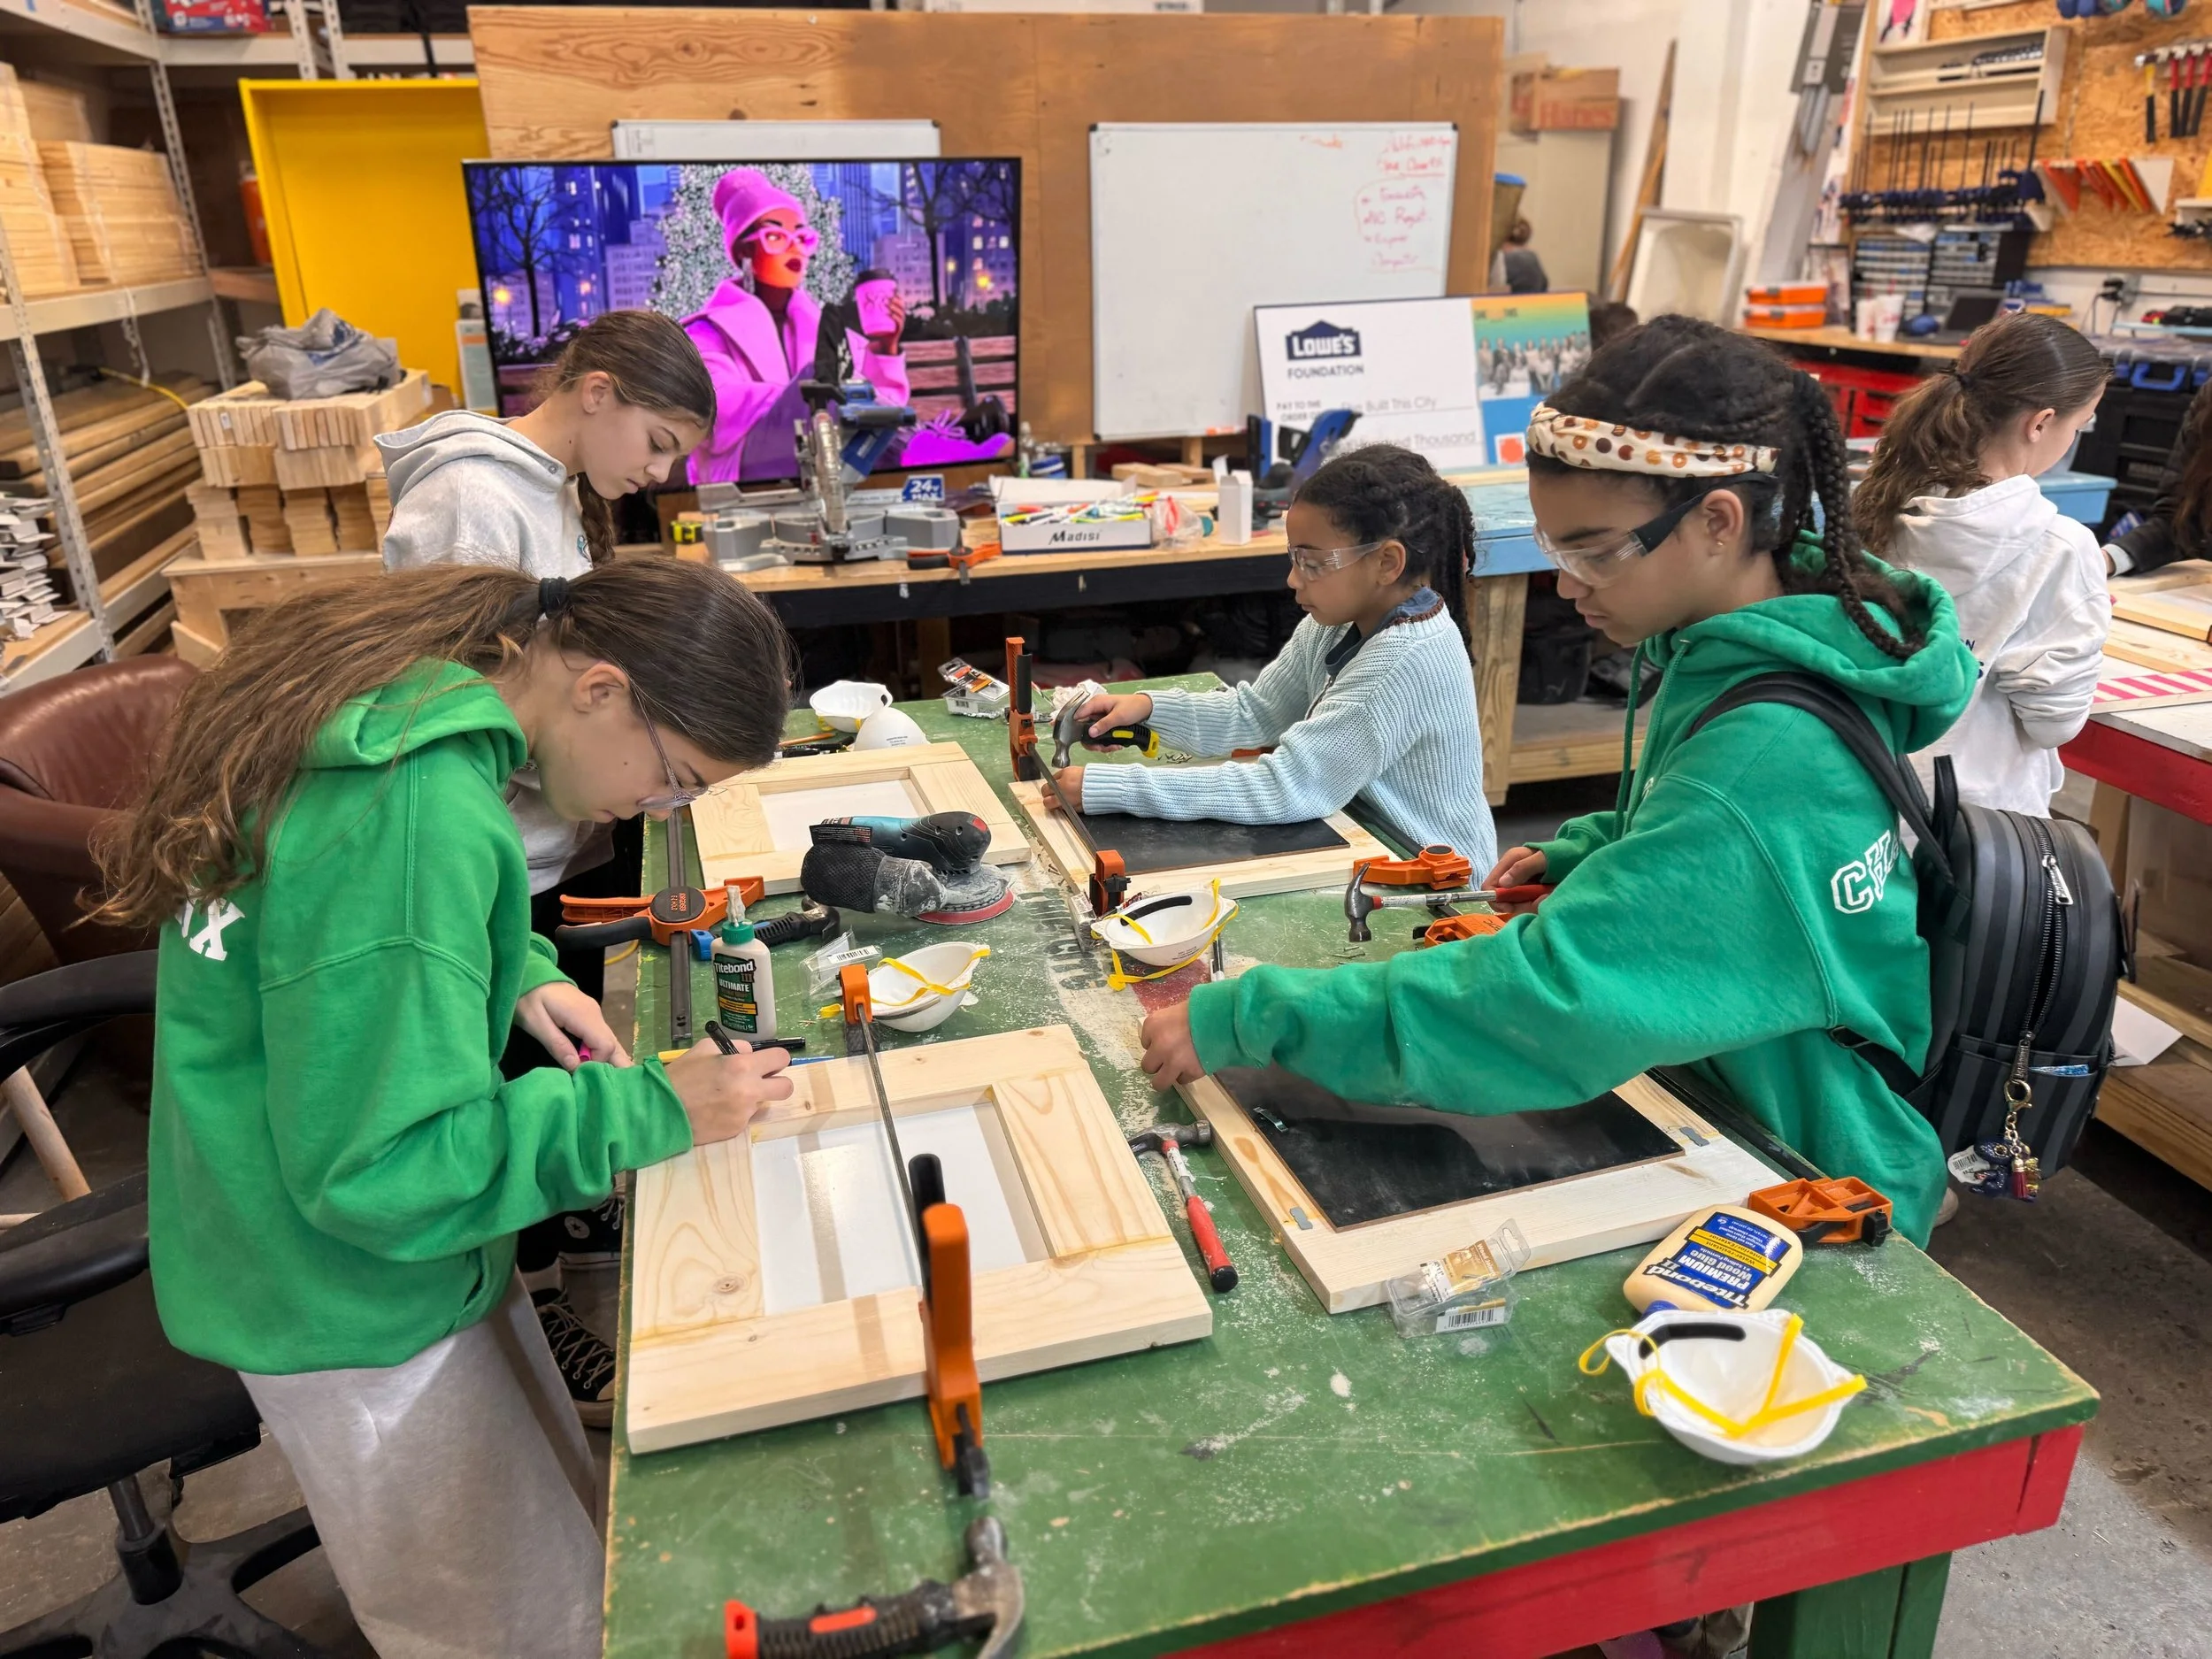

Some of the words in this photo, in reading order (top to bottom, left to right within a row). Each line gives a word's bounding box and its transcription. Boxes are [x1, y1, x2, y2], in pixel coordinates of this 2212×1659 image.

[1292, 334, 1356, 357] LOWE'S
[1287, 364, 1364, 379] FOUNDATION
[1367, 400, 1390, 411] Built
[1392, 398, 1412, 410] This
[1414, 396, 1438, 411] City
[1415, 431, 1476, 447] Thousand
[1048, 530, 1101, 545] Madisi
[714, 960, 756, 974] Titebond
[718, 979, 750, 993] ULTIMATE
[1700, 1248, 1724, 1262] Formula
[1706, 1240, 1755, 1266] Water-resistant
[1709, 1234, 1763, 1260] Interior/Exterior
[1691, 1249, 1717, 1266] Glue
[1678, 1256, 1750, 1289] PREMIUM
[1717, 1262, 1752, 1280] Wood
[1648, 1263, 1747, 1306] Titebond
